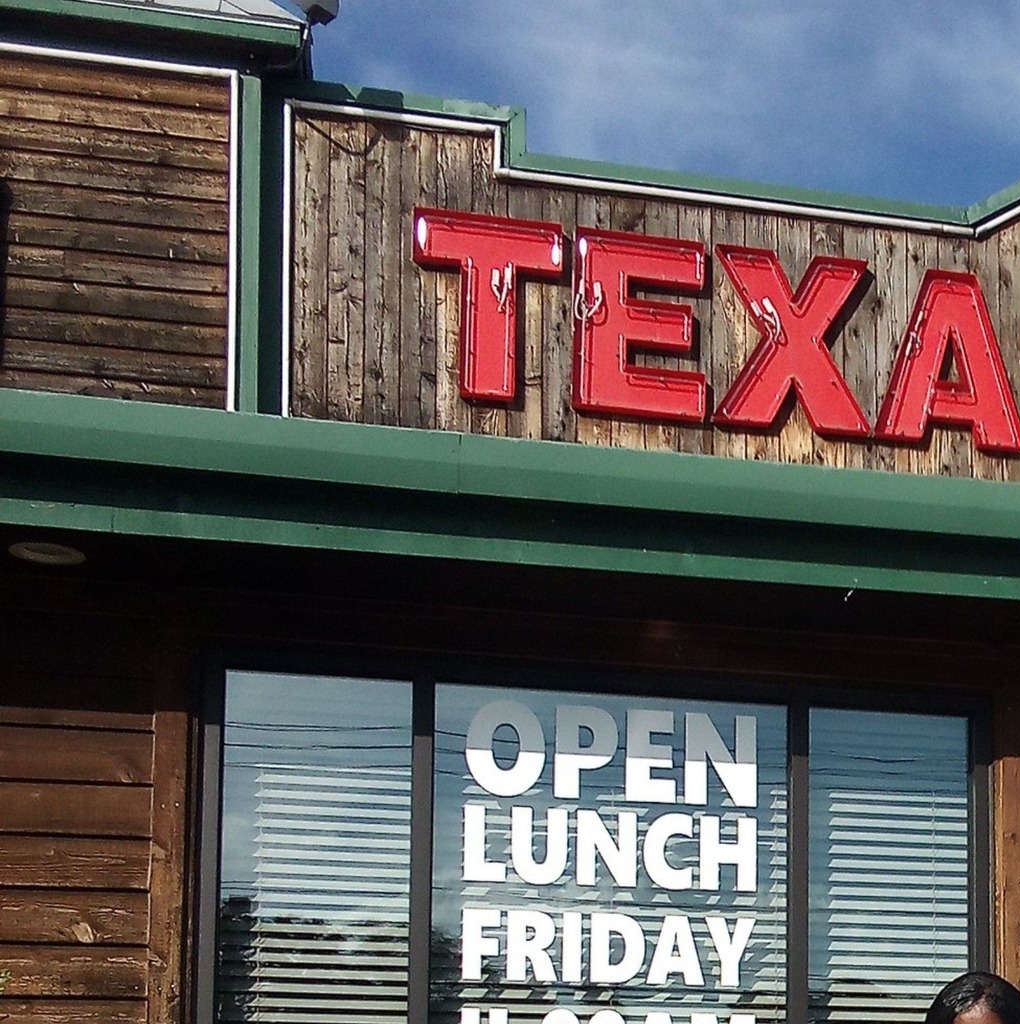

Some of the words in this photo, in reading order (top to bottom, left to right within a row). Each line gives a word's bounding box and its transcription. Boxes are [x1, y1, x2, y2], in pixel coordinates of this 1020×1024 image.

[465, 700, 758, 808] OPEN
[461, 804, 758, 893] LUNCH
[461, 907, 757, 987] FRIDAY
